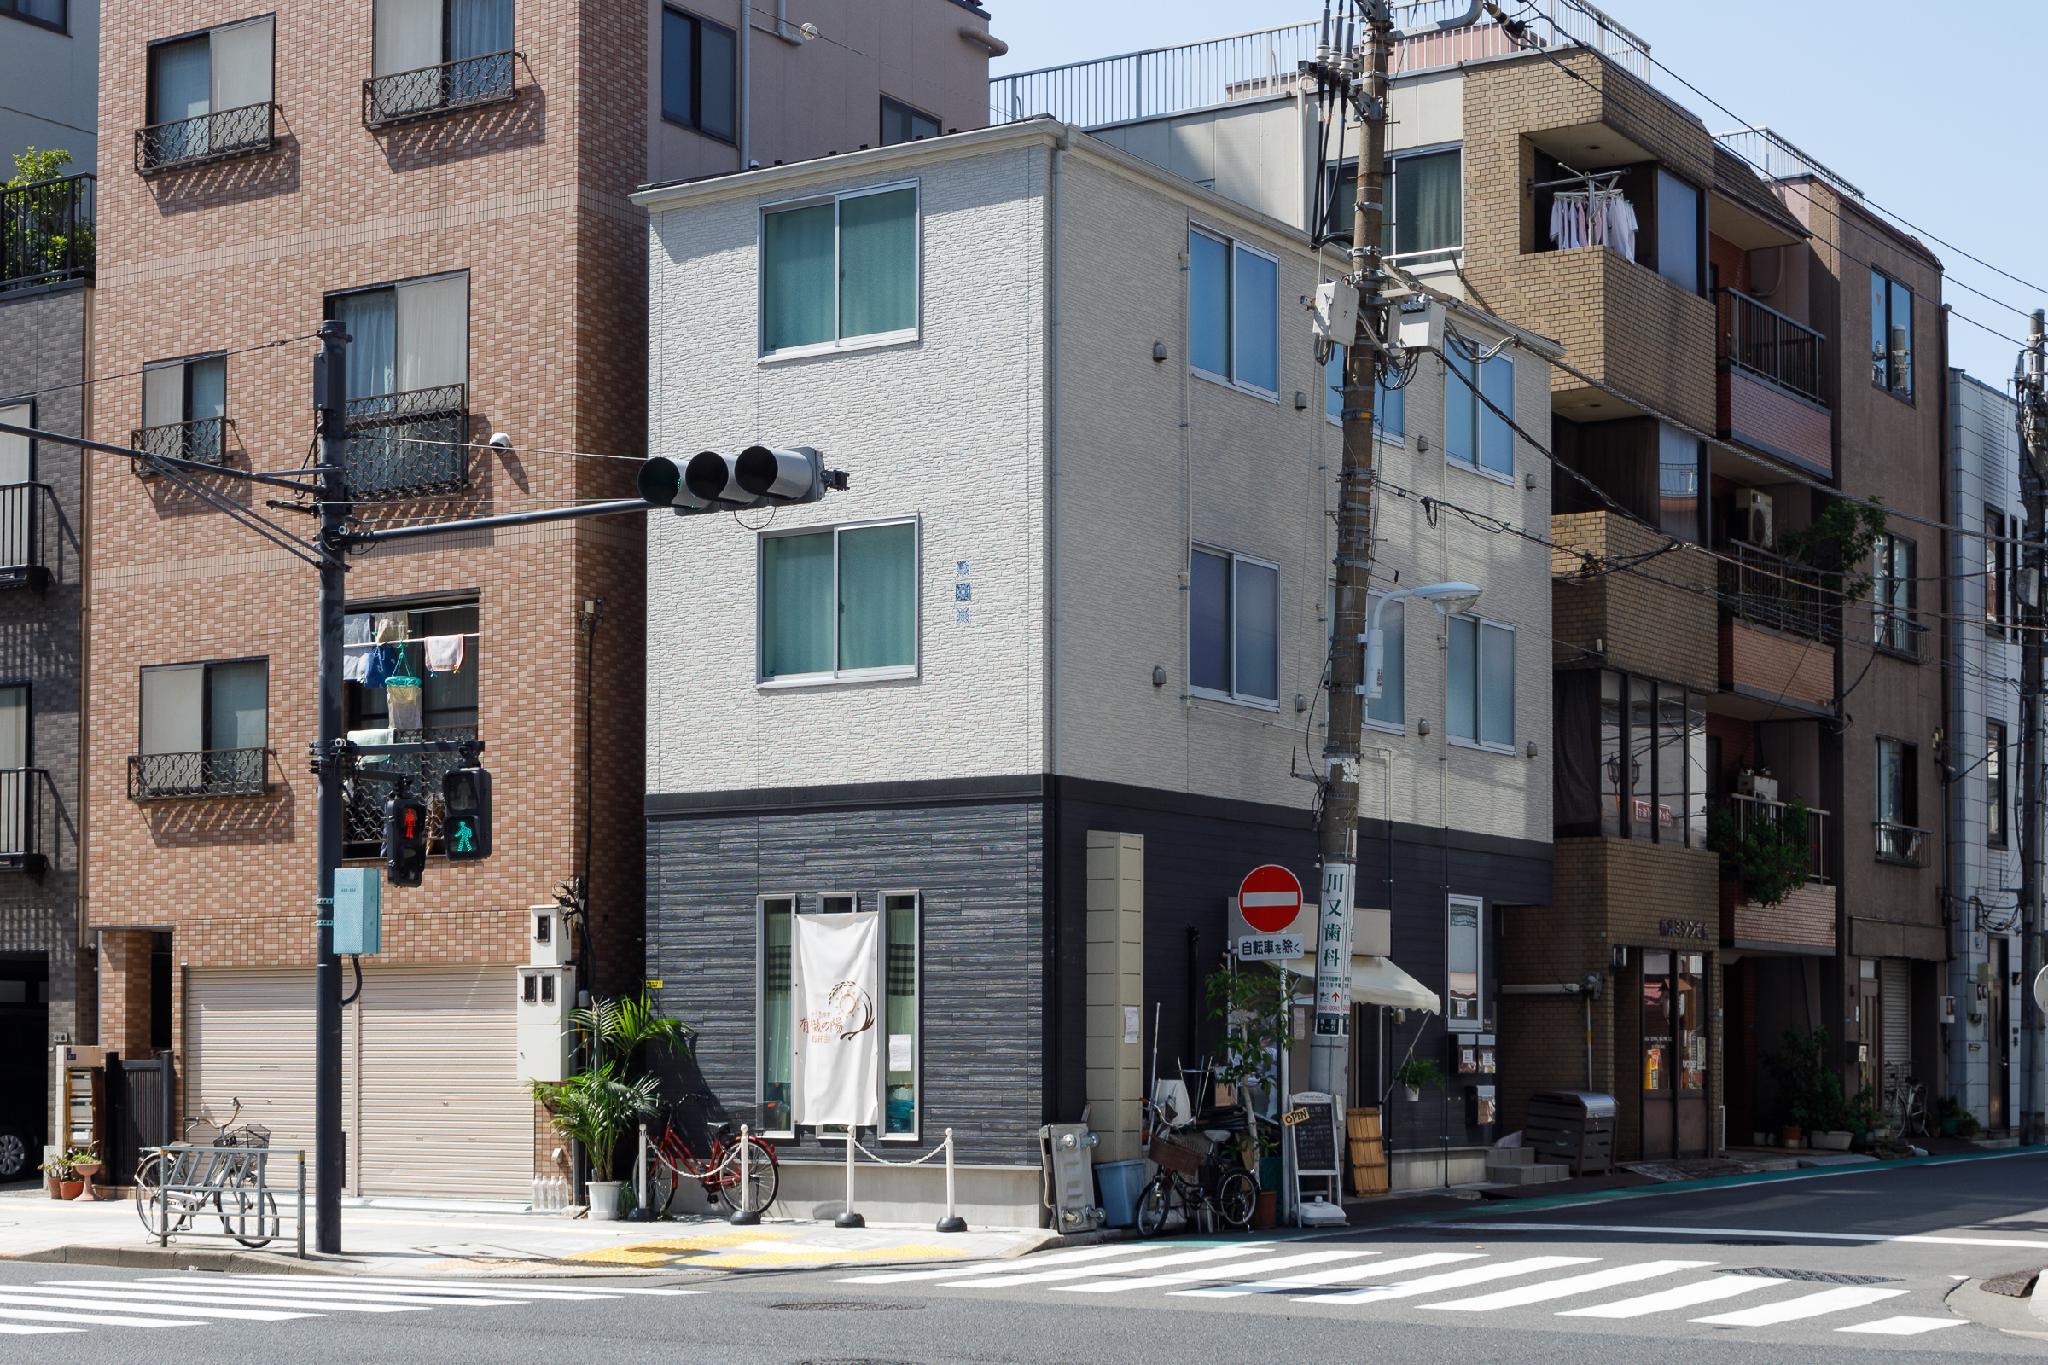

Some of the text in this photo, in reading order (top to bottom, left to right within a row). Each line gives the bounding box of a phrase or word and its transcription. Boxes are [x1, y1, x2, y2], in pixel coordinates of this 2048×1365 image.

[1322, 873, 1344, 968] 川又歯科
[1242, 939, 1300, 956] 自転車を除く
[1285, 1109, 1307, 1124] OPEN
